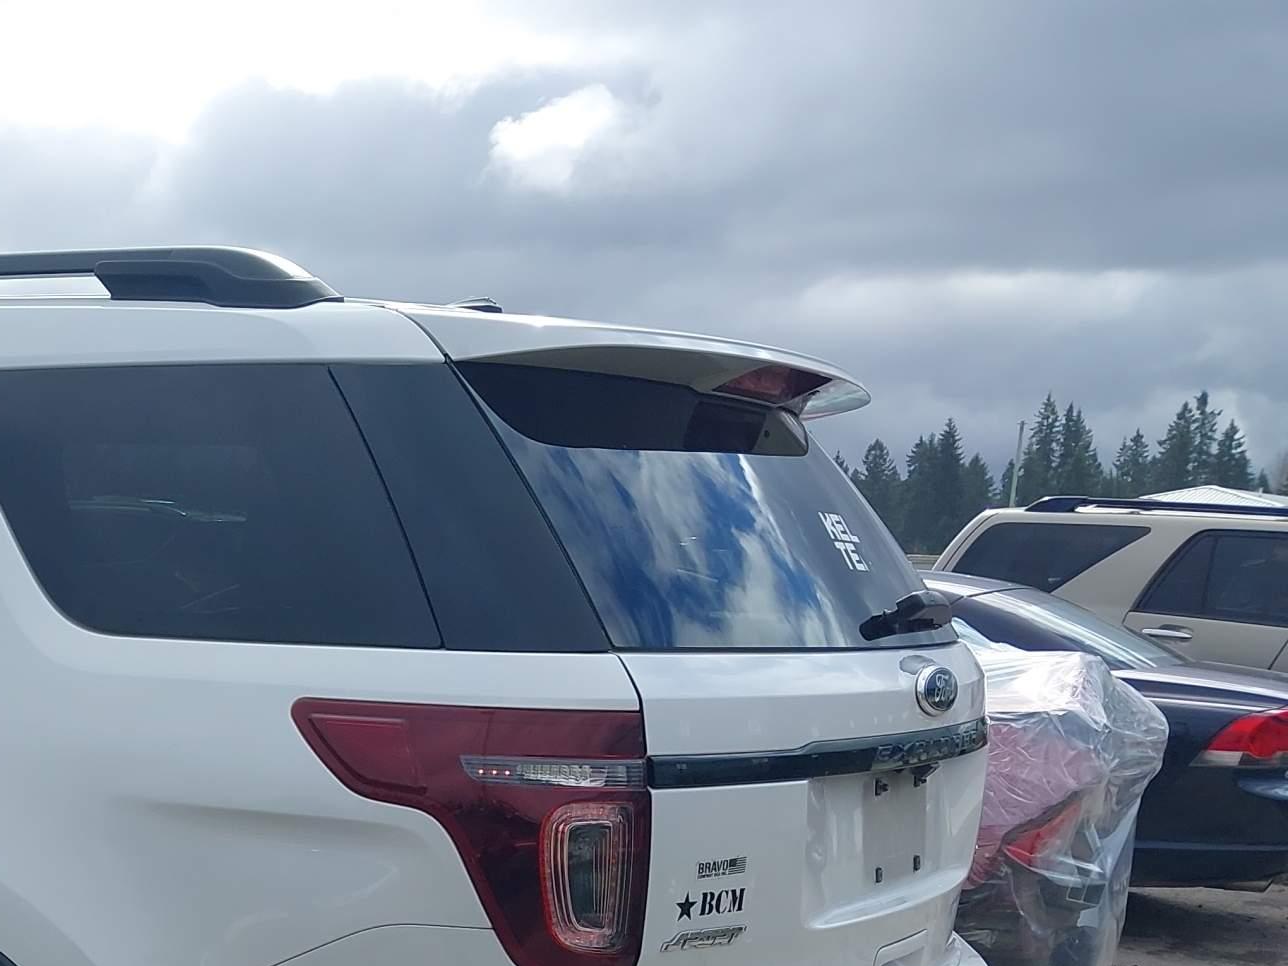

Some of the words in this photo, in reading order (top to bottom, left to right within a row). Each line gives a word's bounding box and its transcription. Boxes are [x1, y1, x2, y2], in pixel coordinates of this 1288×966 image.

[817, 511, 861, 543] KEL
[697, 859, 729, 875] BRAVO
[698, 887, 746, 917] BCM
